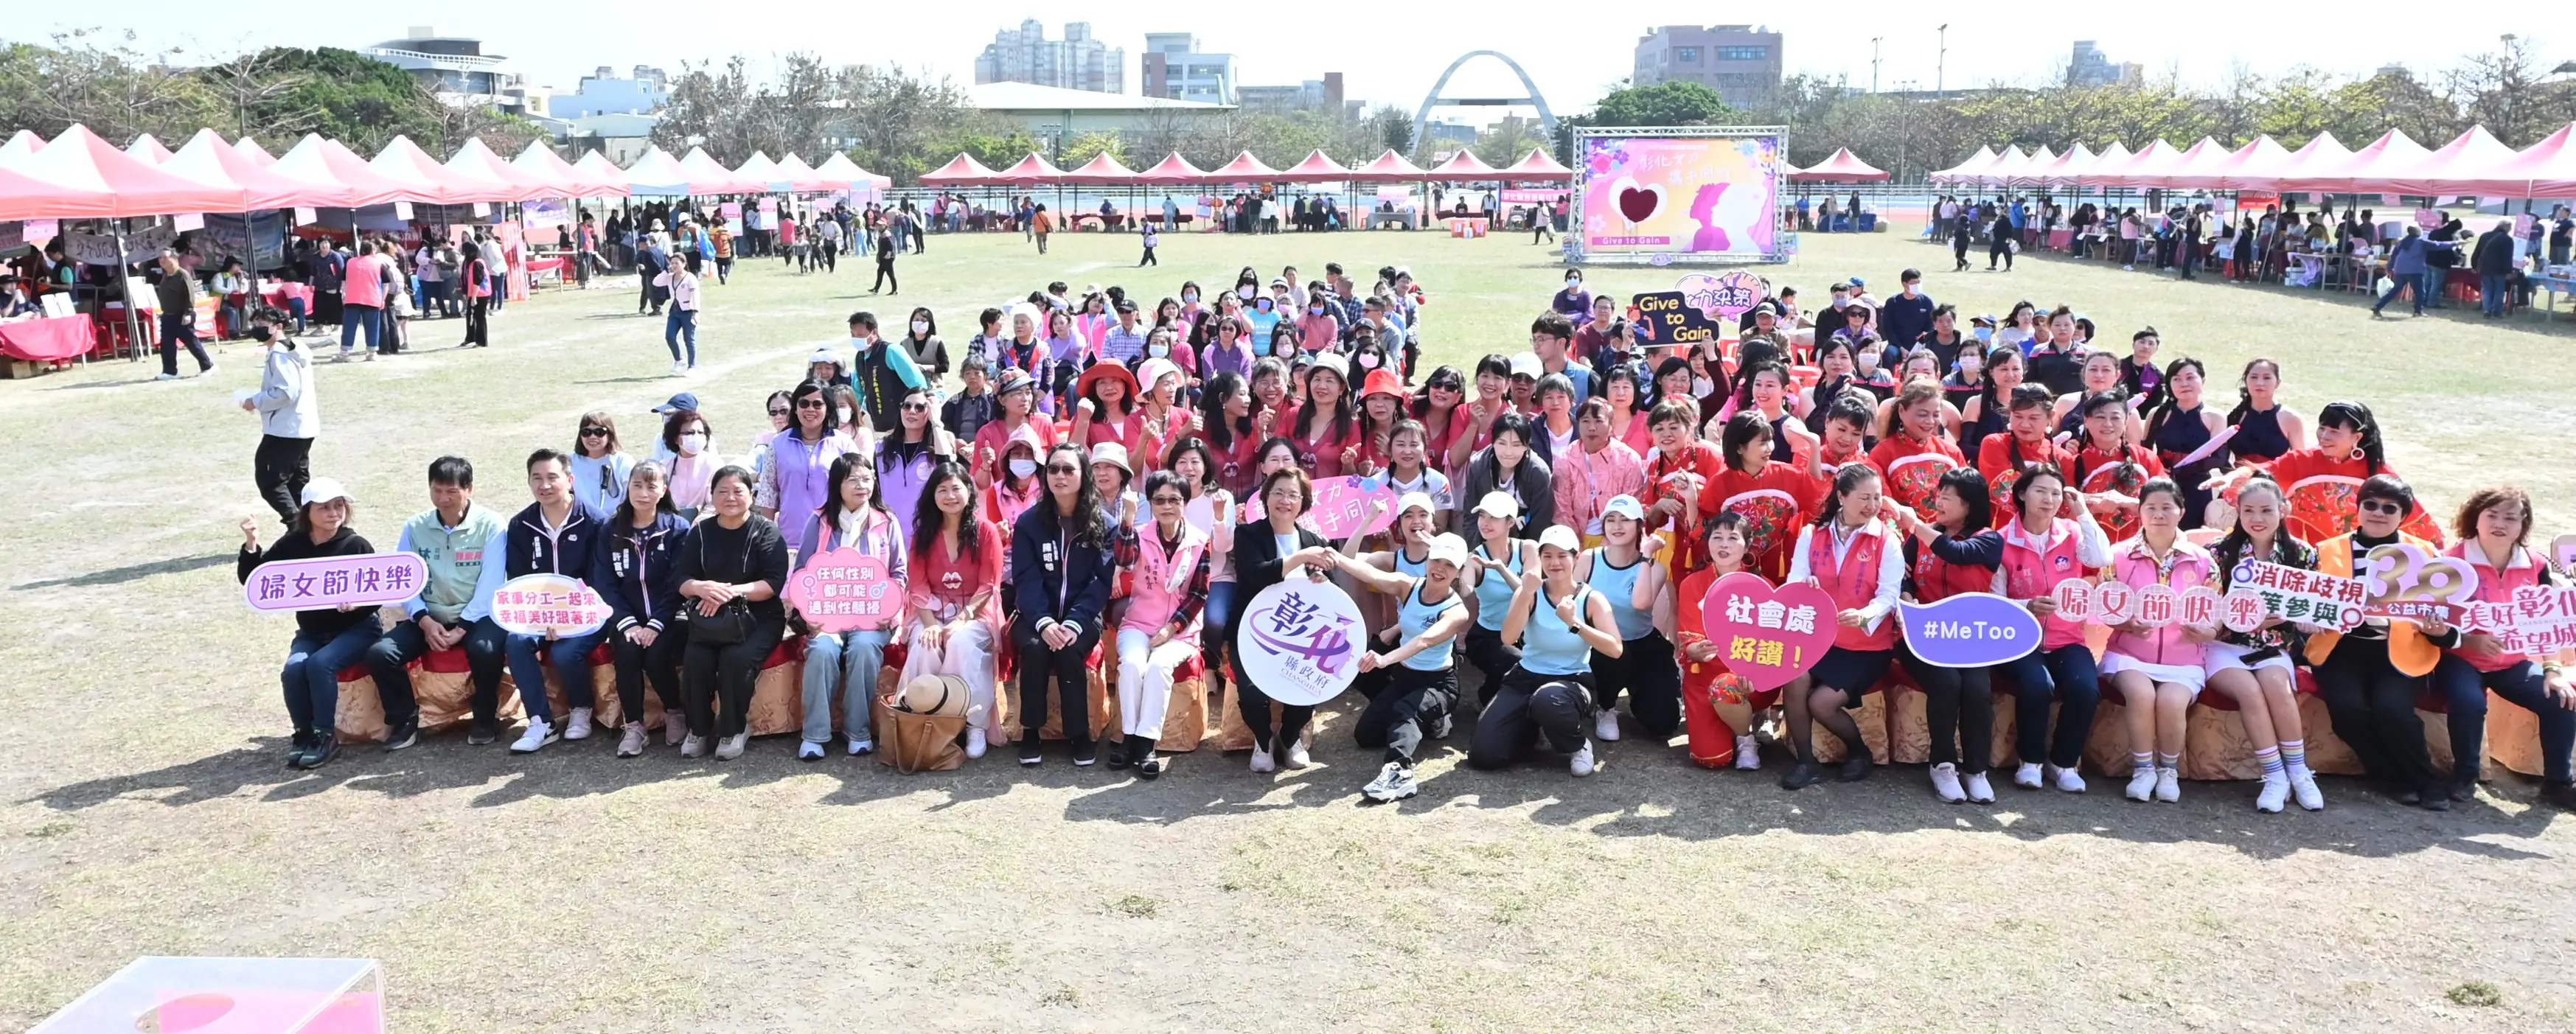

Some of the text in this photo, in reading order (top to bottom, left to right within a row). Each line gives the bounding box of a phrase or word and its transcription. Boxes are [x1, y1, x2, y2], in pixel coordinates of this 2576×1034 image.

[1602, 237, 1622, 245] Give
[1639, 296, 1679, 312] Give
[1665, 312, 1685, 325] to
[1673, 325, 1712, 342] Gain
[260, 565, 413, 601] 婦女節快樂
[816, 567, 874, 581] 任何性別
[2367, 546, 2463, 602] 38
[824, 583, 867, 598] 都可能
[2253, 563, 2364, 605] 消除歧視
[495, 591, 596, 607] 家事分工一起來
[807, 600, 881, 615] 遇到性騷擾
[2061, 587, 2260, 626] 婦女節快樂
[2234, 585, 2339, 626] 等參與
[499, 609, 599, 625] 幸福美好跟著來
[1725, 593, 1817, 635] 社會處
[1270, 591, 1345, 674] 彰化
[1924, 621, 2016, 640] #MeToo
[1284, 655, 1331, 688] 縣政府
[1281, 667, 1322, 696] CHANGHUA
